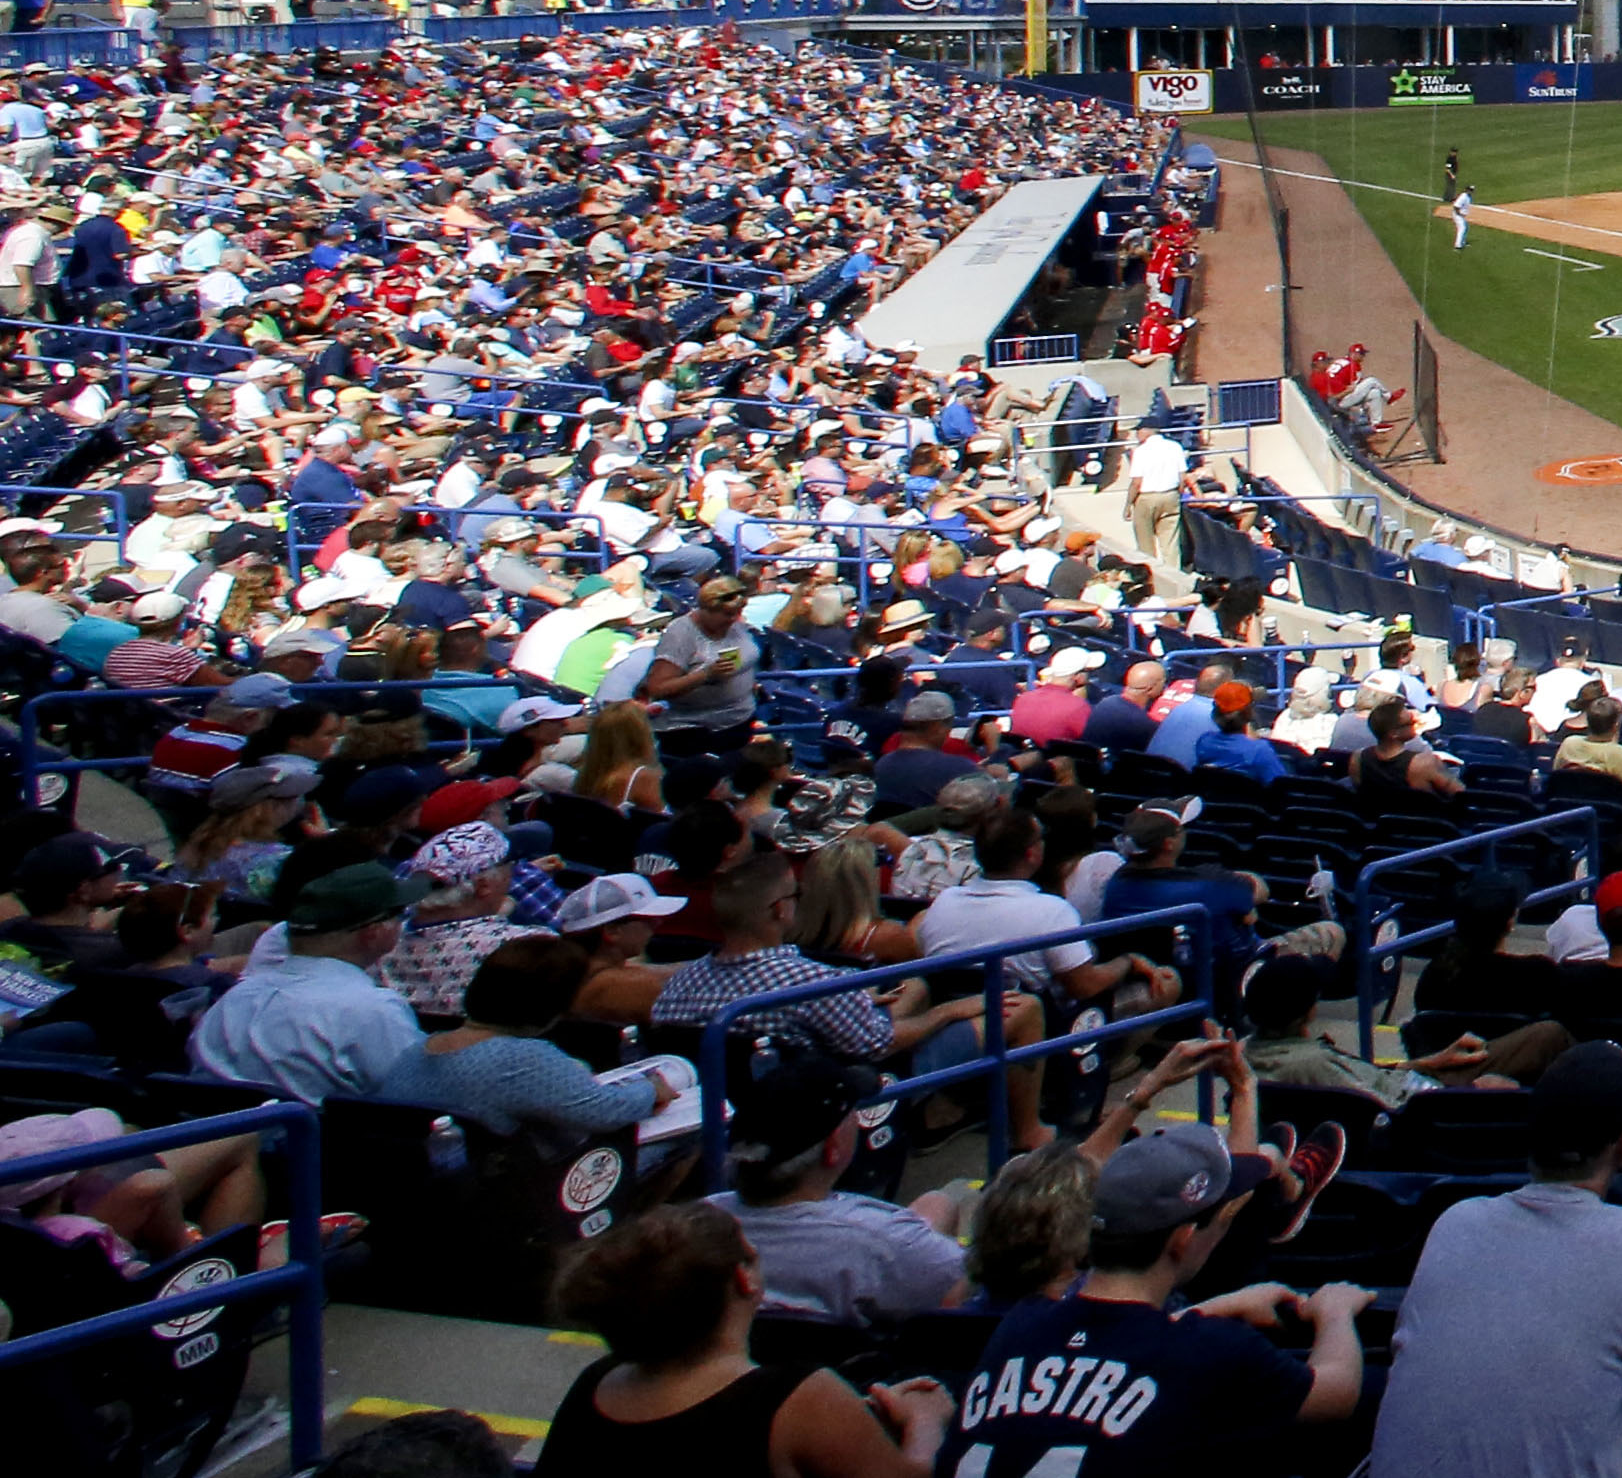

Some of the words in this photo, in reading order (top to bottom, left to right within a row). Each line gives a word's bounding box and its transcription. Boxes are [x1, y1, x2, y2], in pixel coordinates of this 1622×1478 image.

[1148, 76, 1198, 98] vigo
[1420, 76, 1446, 85] STAY
[1262, 85, 1320, 94] COACH
[1420, 84, 1471, 94] AMERICA
[180, 1336, 215, 1365] MM
[961, 1356, 1159, 1438] CASTRO
